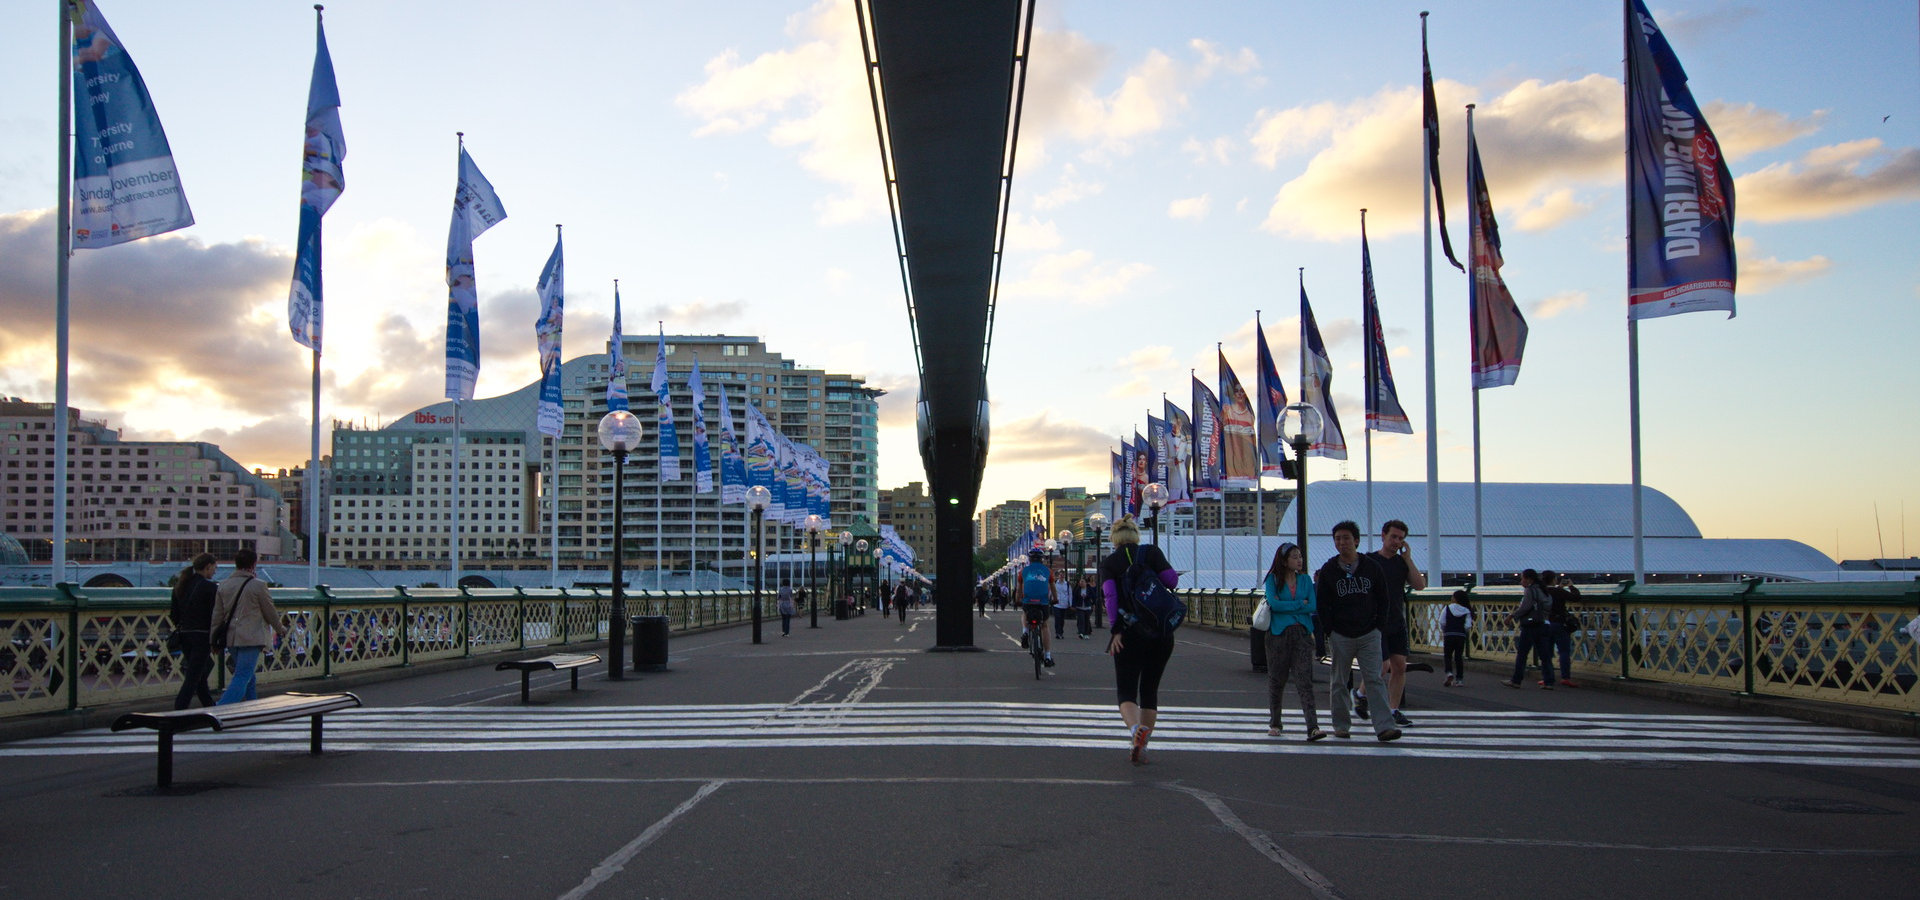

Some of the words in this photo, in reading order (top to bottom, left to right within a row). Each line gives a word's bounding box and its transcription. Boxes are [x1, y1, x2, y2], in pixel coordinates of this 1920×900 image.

[103, 140, 134, 155] ourne
[1663, 141, 1701, 261] DARLING
[415, 411, 436, 424] ibis
[439, 416, 464, 424] HOTL
[1336, 577, 1371, 597] GAP
